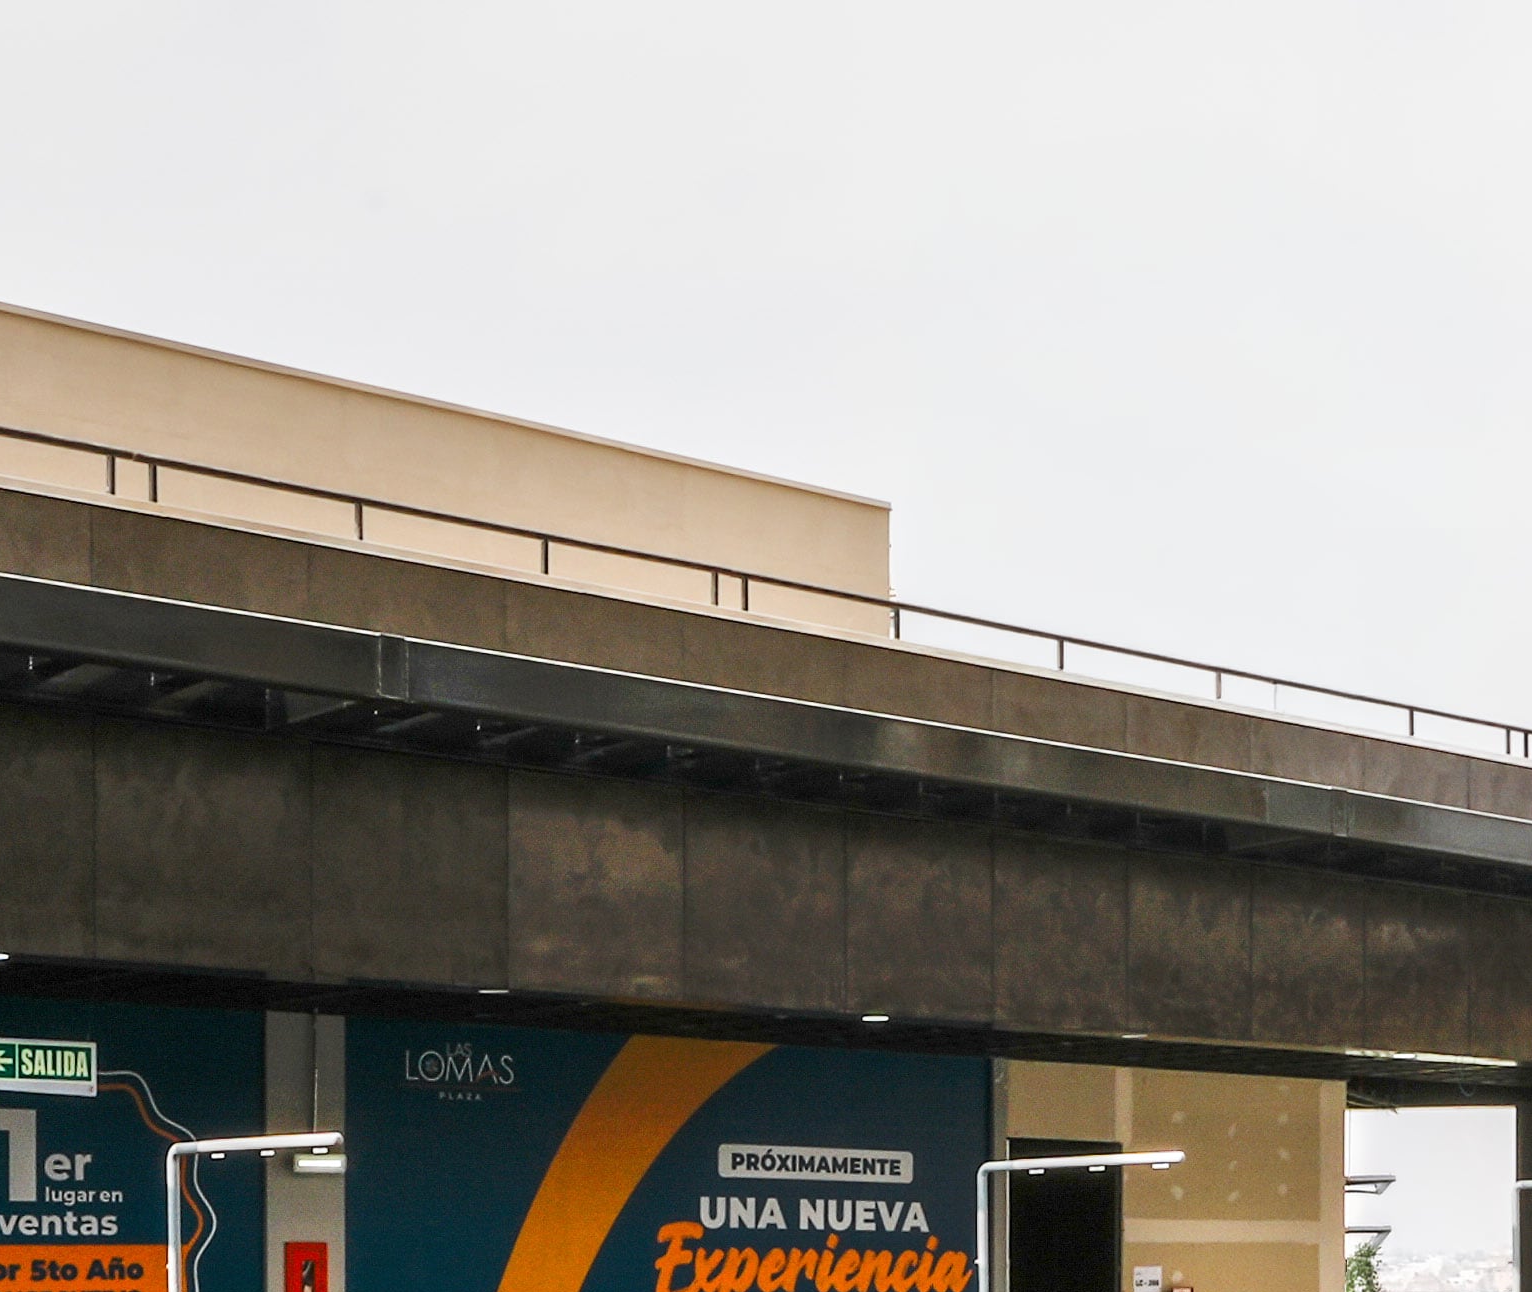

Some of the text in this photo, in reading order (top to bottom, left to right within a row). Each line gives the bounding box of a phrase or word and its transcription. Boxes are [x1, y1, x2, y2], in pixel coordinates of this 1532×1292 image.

[20, 1048, 89, 1078] SALIDA
[446, 1043, 472, 1057] LAS
[406, 1050, 514, 1085] LOMAS
[439, 1091, 482, 1101] PLAZA
[731, 1149, 901, 1177] PRÓXIMAMENTE
[45, 1187, 123, 1206] lugar en
[700, 1197, 929, 1232] UNA NUEVA
[31, 1259, 78, 1281] 5to
[86, 1257, 144, 1281] Año
